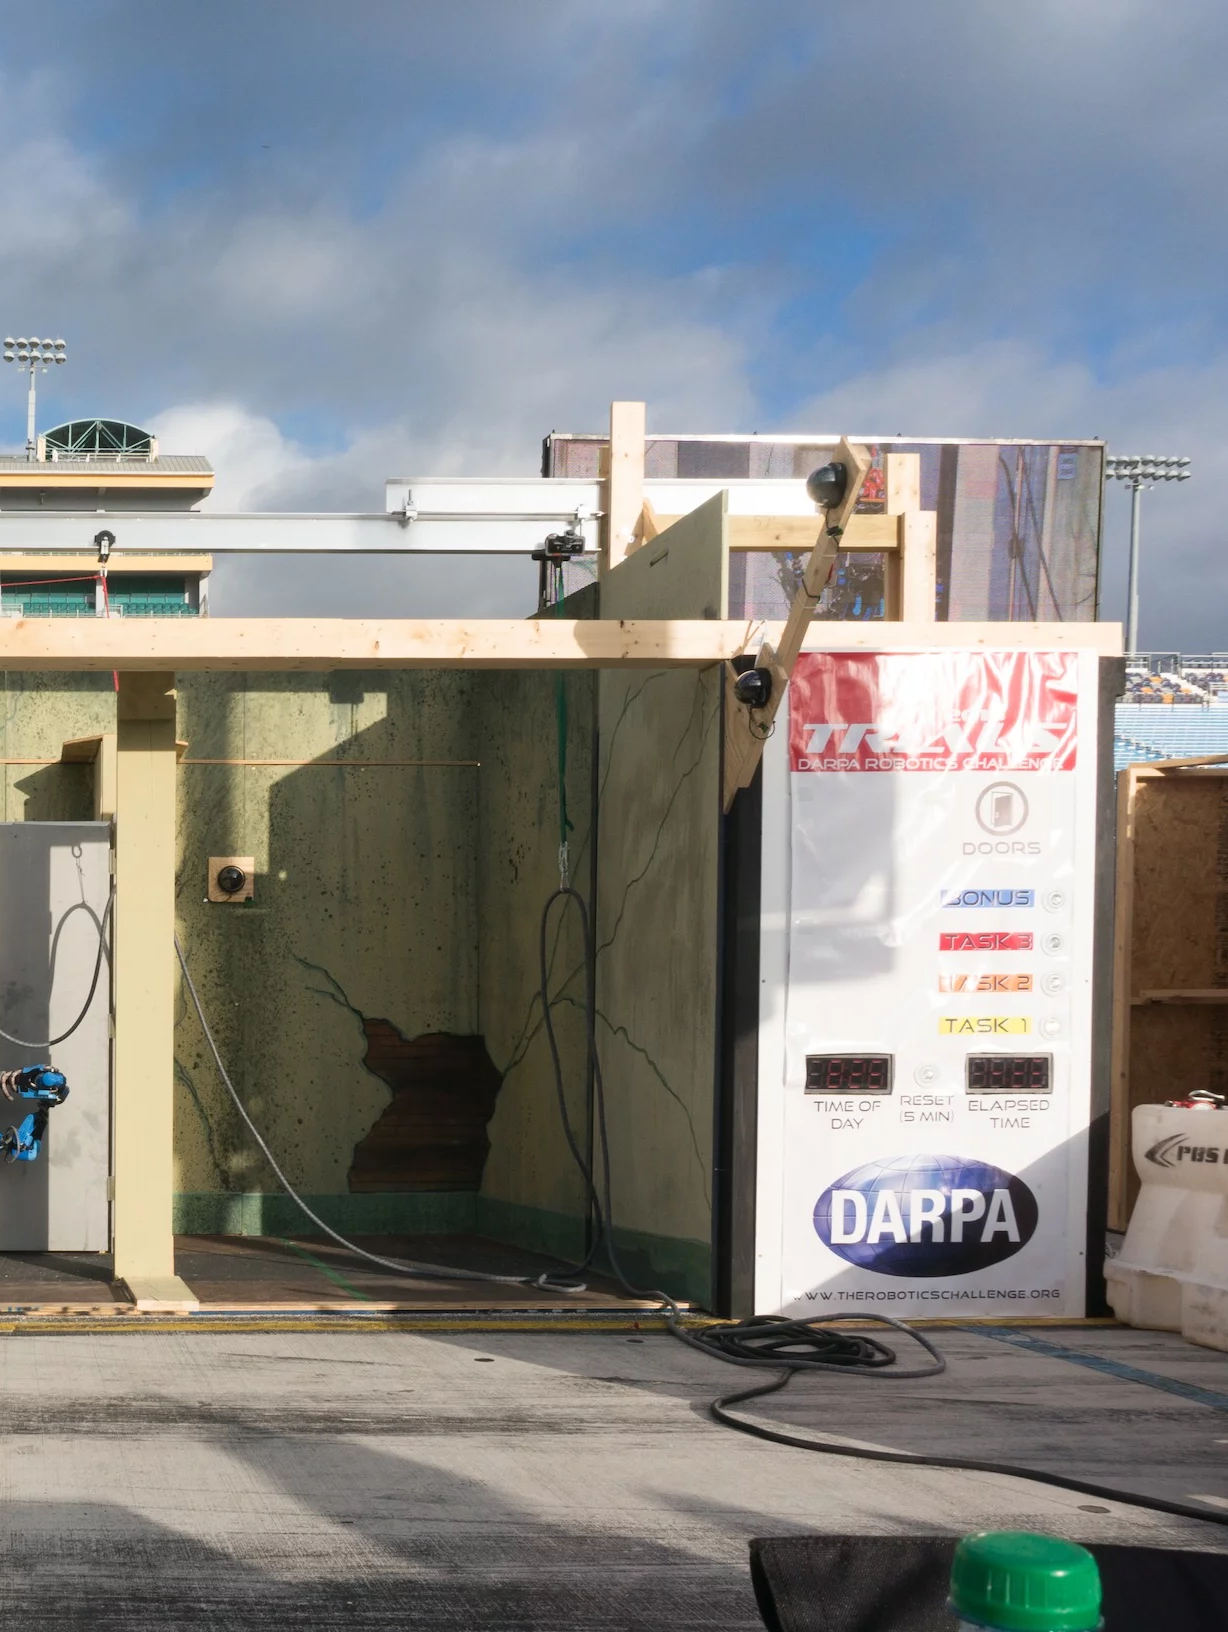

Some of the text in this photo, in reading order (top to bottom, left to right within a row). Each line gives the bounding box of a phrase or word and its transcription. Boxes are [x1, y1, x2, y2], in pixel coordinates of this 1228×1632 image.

[803, 722, 1069, 754] TRALS
[798, 757, 1064, 770] DARPA ROBOTICS CHALENGE
[962, 841, 1042, 856] DOORS
[945, 934, 1033, 950] TASK 3
[1017, 975, 1030, 991] 2
[945, 1018, 1028, 1033] TASK 1
[813, 1100, 882, 1112] TIME OF
[900, 1094, 955, 1106] RESET
[967, 1099, 1050, 1112] ELAPSED
[831, 1117, 864, 1130] DAY
[989, 1116, 1031, 1129] TIME
[830, 1188, 1021, 1245] DARPA
[793, 1288, 1061, 1301] WW.THEROBOTICSCHALLENGE.ORG
